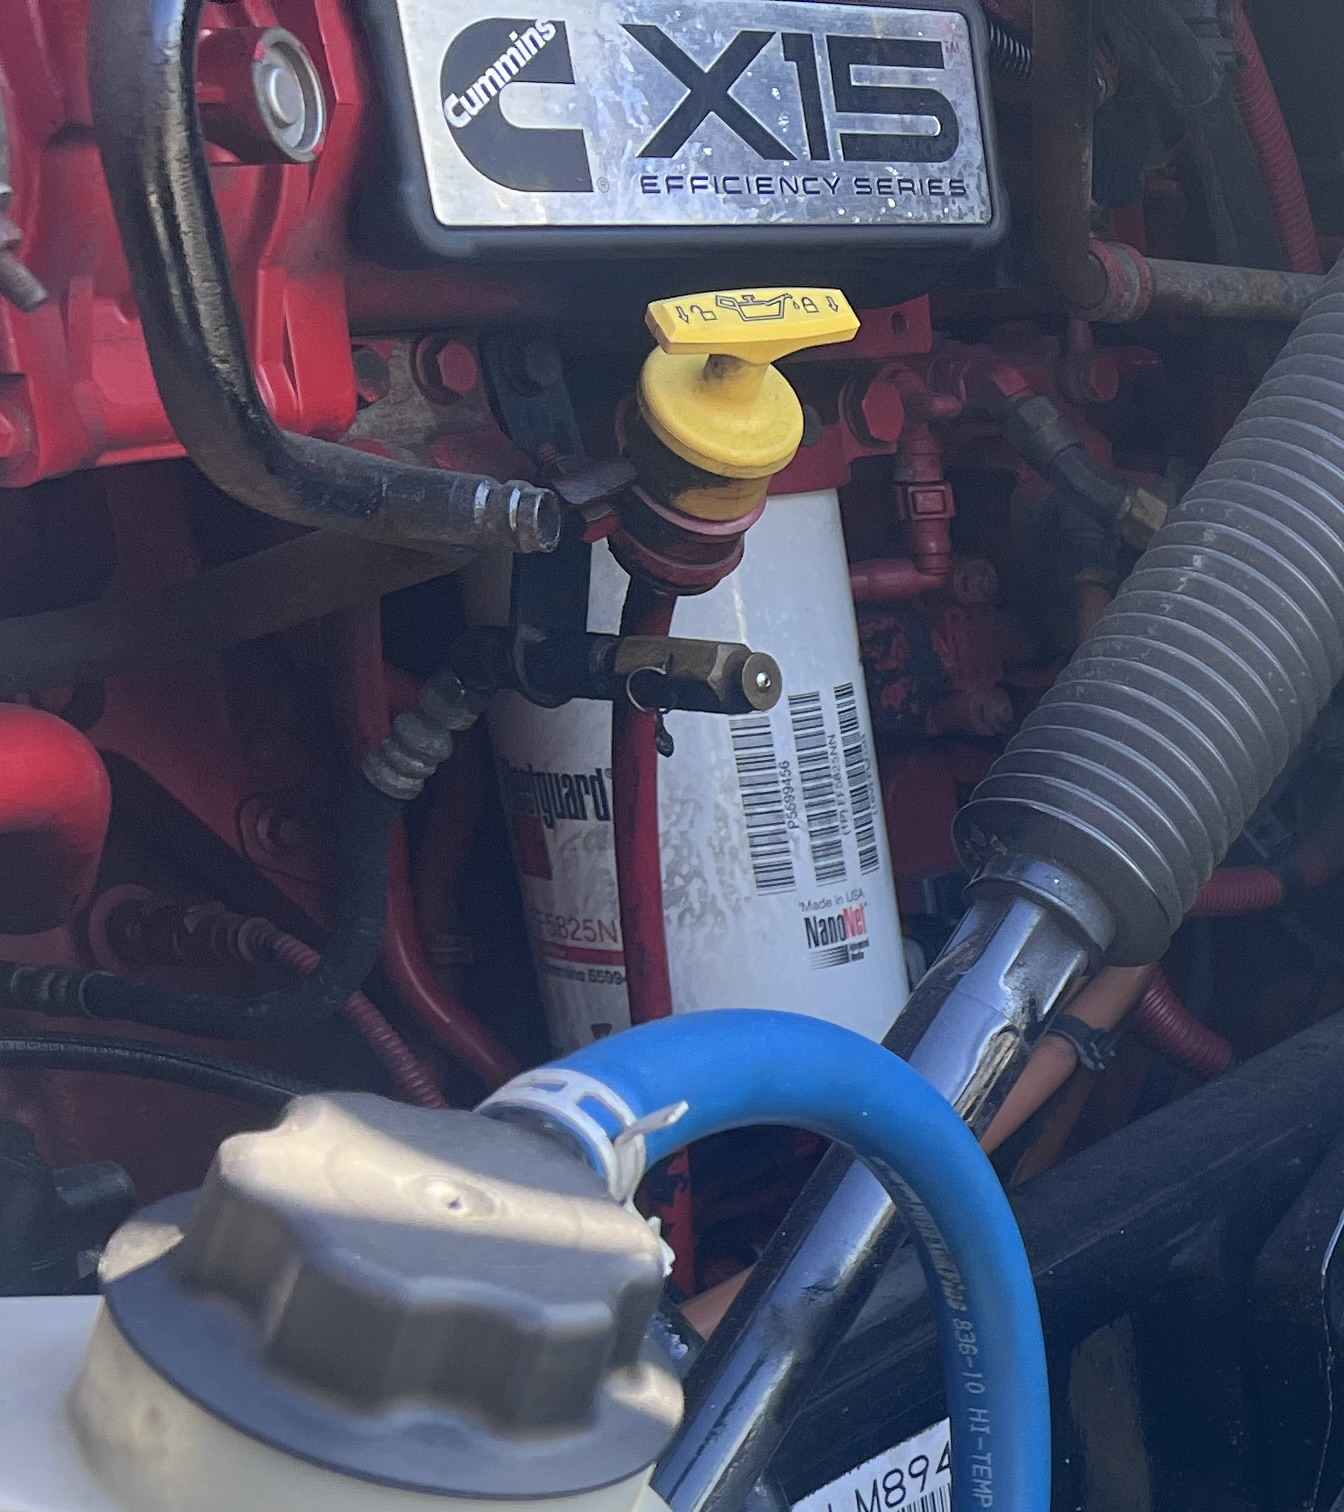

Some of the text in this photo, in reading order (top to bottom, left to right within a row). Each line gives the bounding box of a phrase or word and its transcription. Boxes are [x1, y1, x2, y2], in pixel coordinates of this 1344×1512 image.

[443, 20, 556, 128] Cummins
[619, 23, 961, 162] X15
[639, 174, 967, 197] EFFICIENCY SERIES
[952, 1316, 986, 1395] 836-10
[966, 1407, 993, 1509] HI-TEMP
